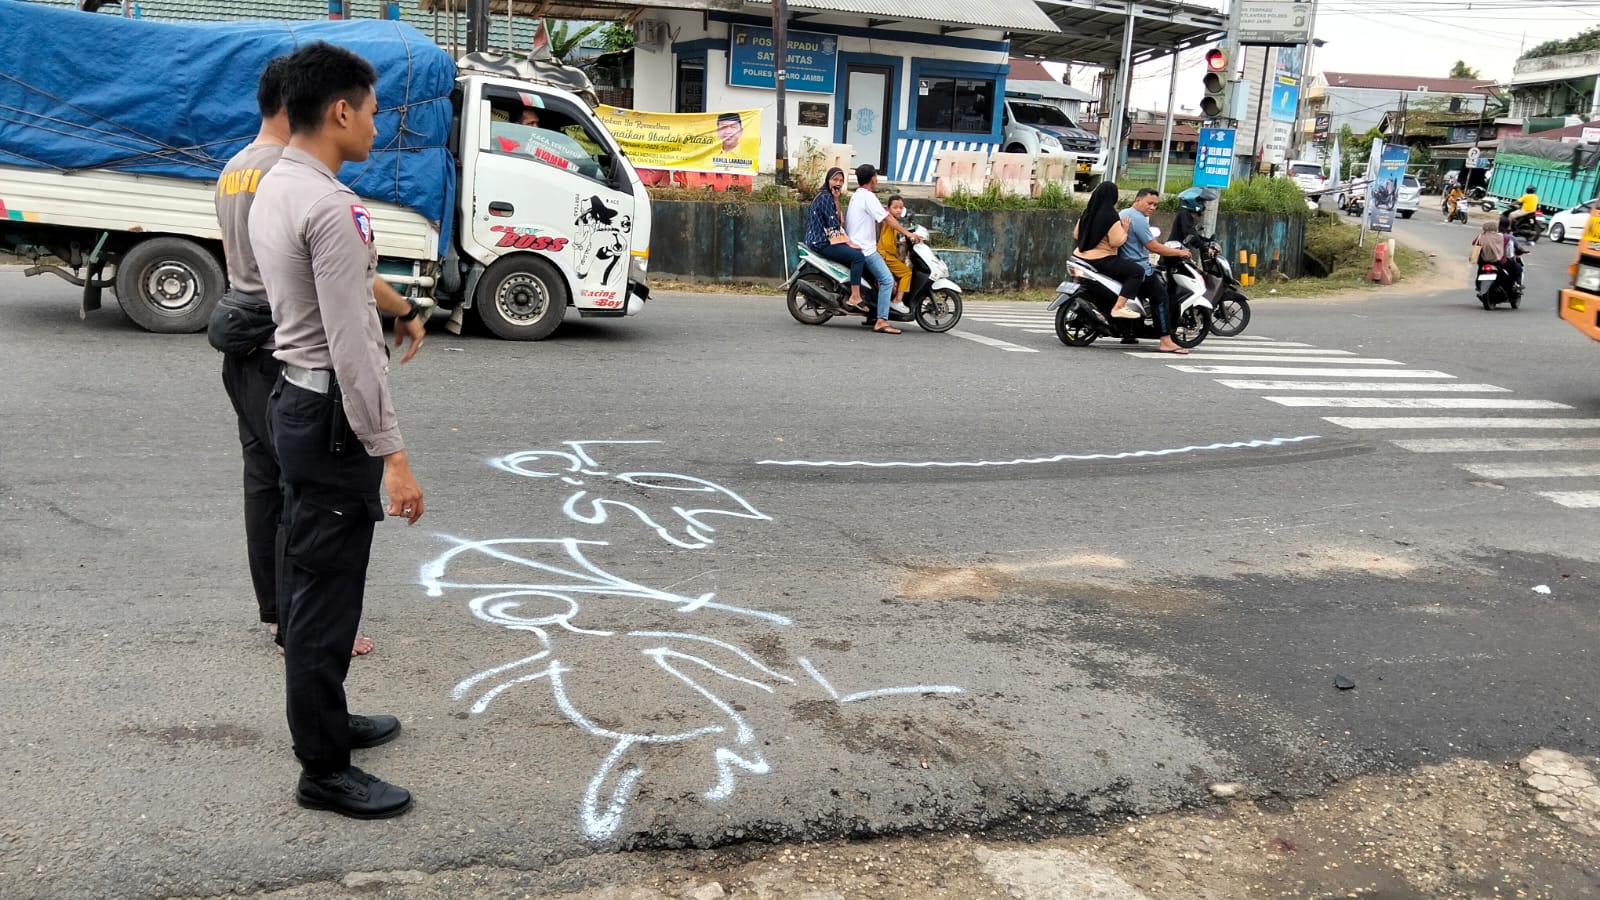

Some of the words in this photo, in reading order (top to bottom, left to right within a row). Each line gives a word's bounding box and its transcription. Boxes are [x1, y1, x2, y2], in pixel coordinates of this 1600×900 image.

[752, 37, 772, 46] POS
[786, 40, 818, 52] RPADU
[757, 51, 813, 65] SATNTAS
[743, 68, 772, 78] POLRES
[774, 72, 800, 80] ARO
[802, 74, 824, 82] JAMBI
[531, 133, 550, 145] KACA
[683, 134, 714, 145] Puasa
[219, 168, 262, 198] POLISI
[495, 231, 569, 252] BOSS
[580, 288, 617, 299] Racing
[594, 298, 622, 308] Boy
